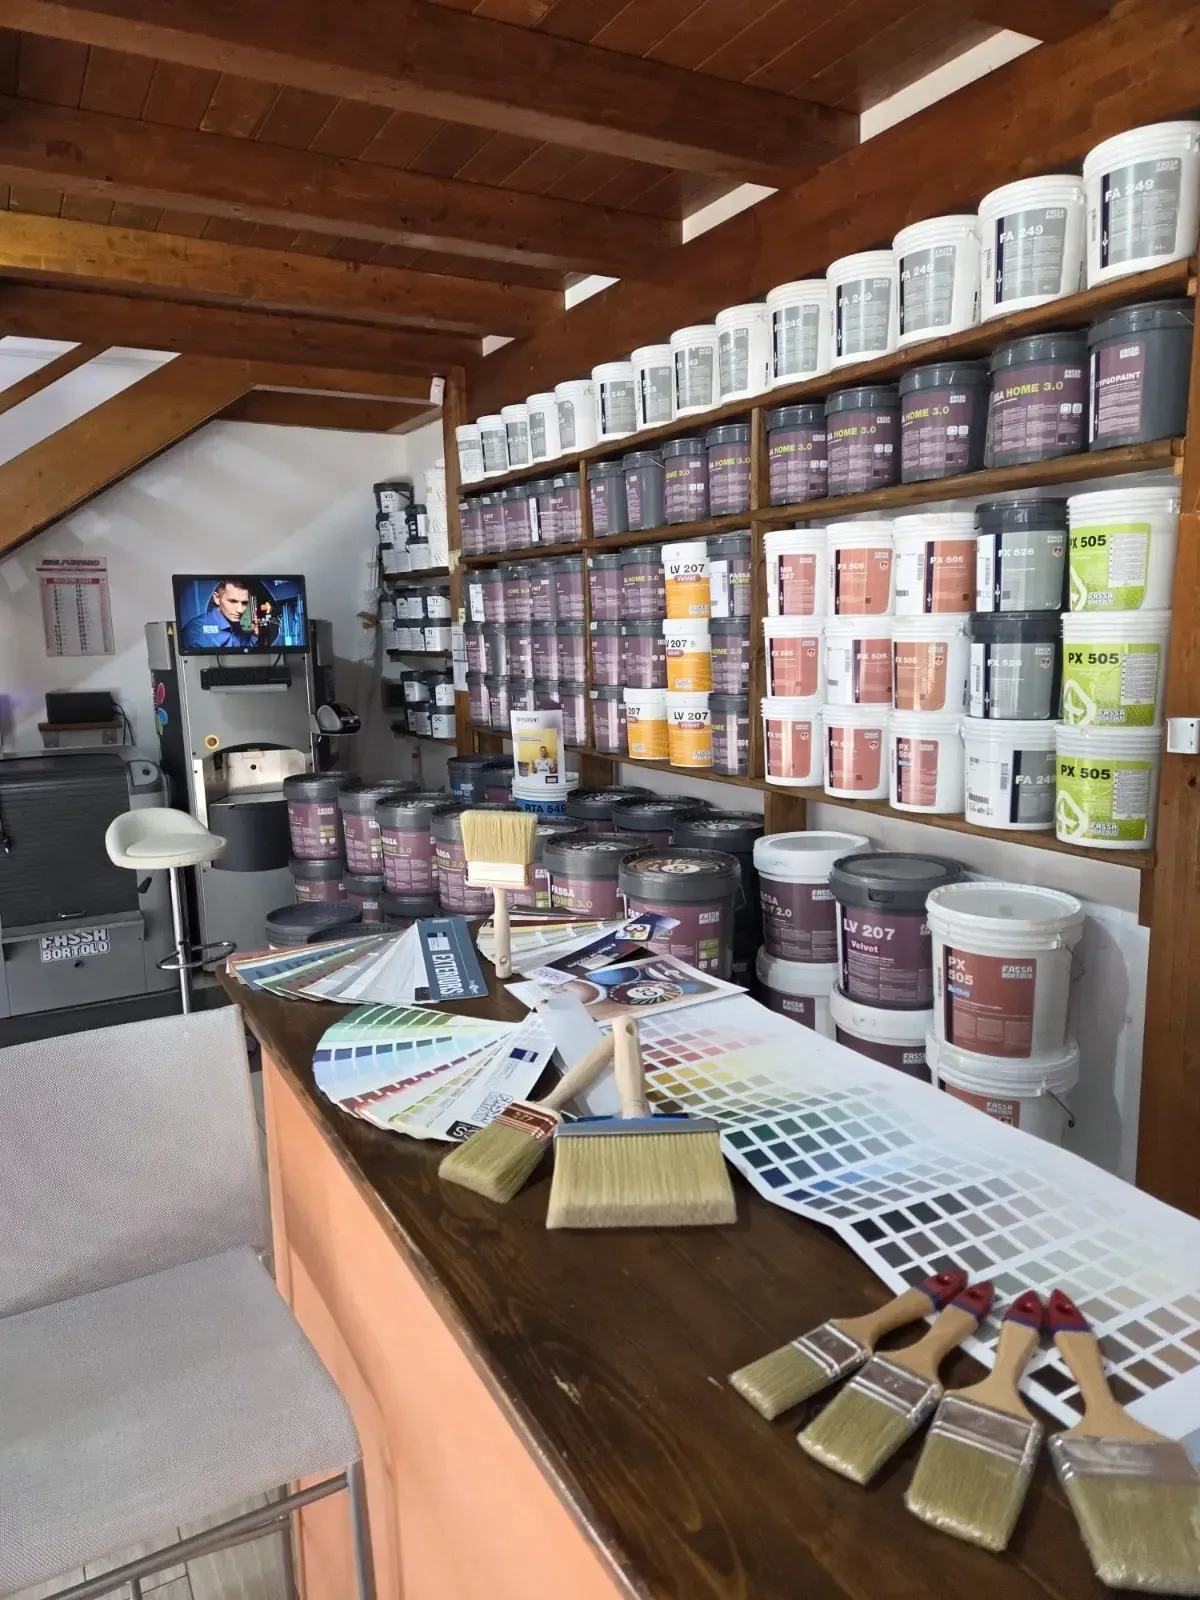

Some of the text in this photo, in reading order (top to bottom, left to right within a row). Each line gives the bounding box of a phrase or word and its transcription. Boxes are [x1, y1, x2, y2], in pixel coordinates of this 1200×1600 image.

[1105, 178, 1155, 203] FA 249
[1000, 225, 1043, 243] FA 249
[901, 263, 934, 281] FA 249
[839, 298, 849, 307] FA
[1006, 383, 1040, 398] HOME
[1043, 381, 1064, 392] 3.0
[905, 406, 949, 421] HOME 3.0
[833, 427, 857, 438] HOME
[860, 426, 876, 435] 3.0
[774, 443, 812, 454] HOME 3.0
[714, 457, 751, 468] HOME 3.0
[679, 469, 690, 477] 3.0
[1080, 535, 1107, 548] 505
[1013, 548, 1034, 556] 526
[946, 556, 964, 564] 505
[670, 564, 705, 574] LV 207
[671, 640, 687, 648] 207
[903, 656, 917, 664] 505
[1003, 659, 1022, 667] 526
[1068, 653, 1119, 664] PX 505
[674, 712, 708, 720] LV 207
[1061, 765, 1111, 780] PX 505
[1015, 775, 1056, 784] FA 249
[525, 804, 566, 813] RTA 549
[551, 885, 575, 897] FASSA
[812, 889, 833, 897] FASS
[575, 900, 592, 909] 3.0
[776, 907, 792, 917] 2.0
[843, 918, 896, 941] LV 207
[41, 929, 107, 949] FASSA
[42, 942, 108, 961] BORTOLO
[851, 939, 880, 953] Velvet
[948, 955, 966, 971] PX
[431, 953, 465, 995] EXTERIORS
[1002, 965, 1033, 973] FASSA
[948, 969, 973, 985] 505
[783, 1000, 804, 1008] FASSA
[987, 1102, 1013, 1110] FASSA
